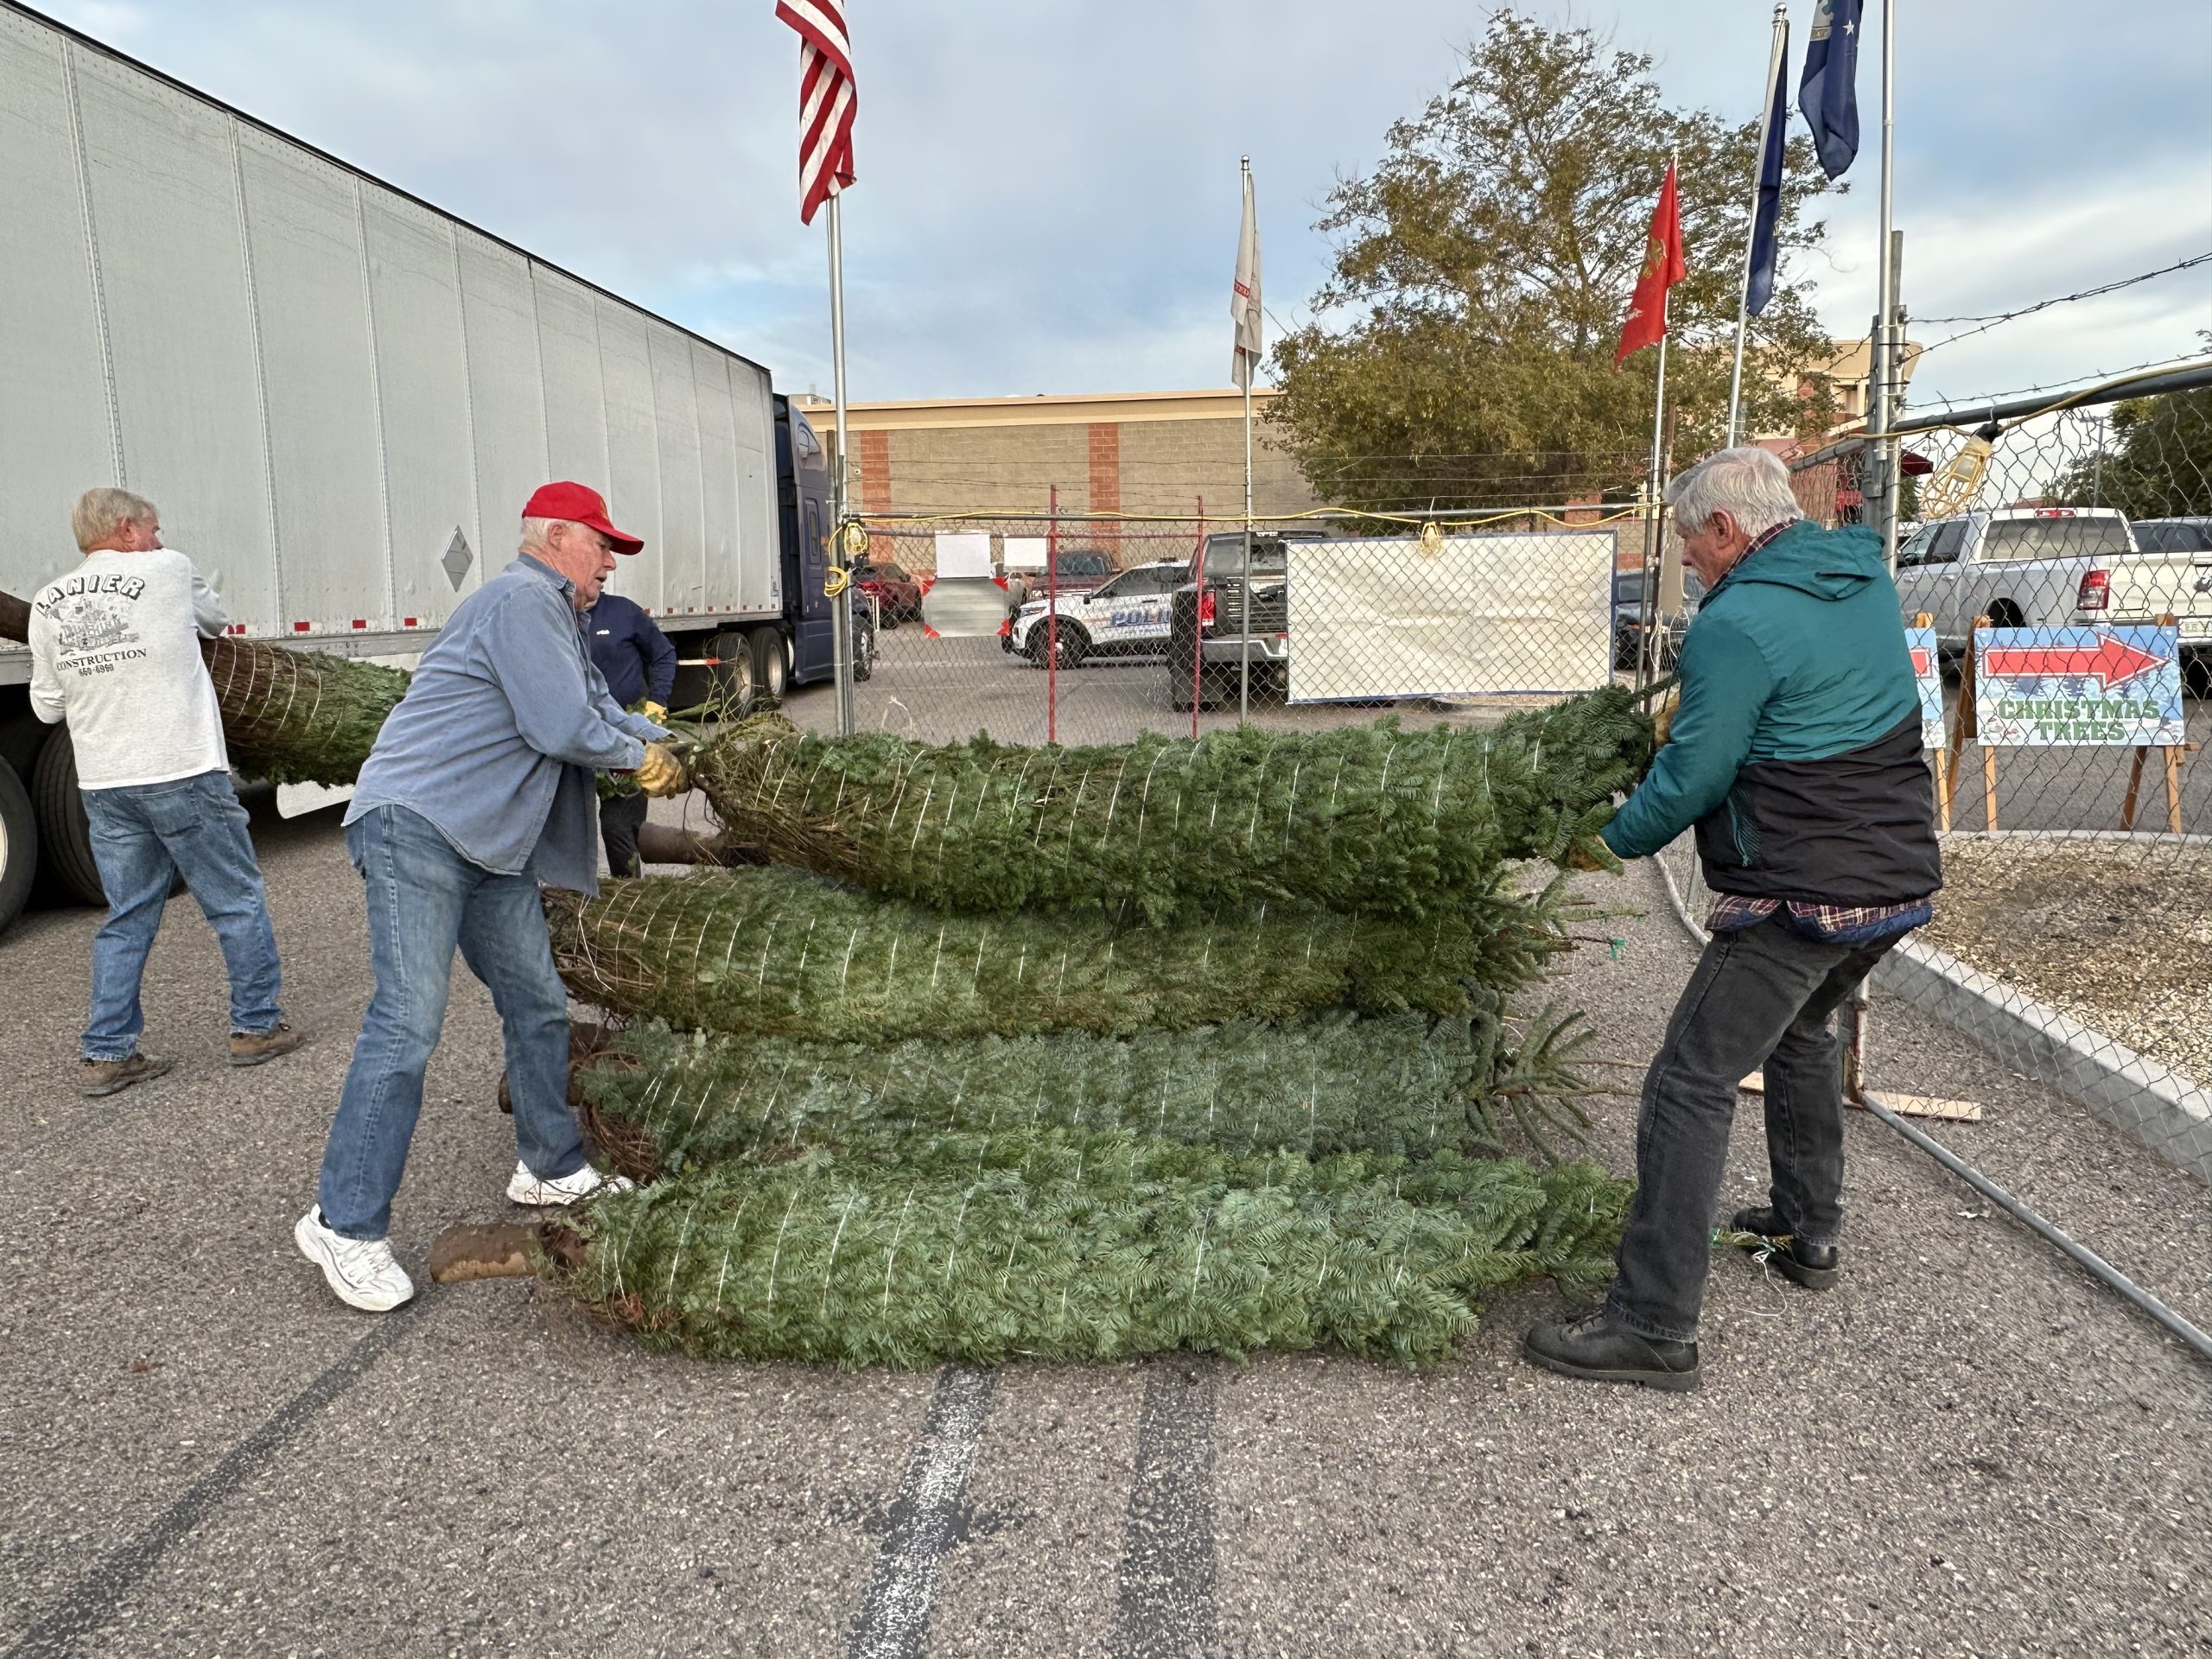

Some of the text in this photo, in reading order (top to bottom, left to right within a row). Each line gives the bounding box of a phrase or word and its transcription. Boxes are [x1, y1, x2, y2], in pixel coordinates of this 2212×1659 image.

[35, 575, 144, 619] LANIER
[57, 649, 146, 671] CONSTRUCTION
[1999, 700, 2160, 719] CHRISTMAS
[2039, 721, 2126, 741] TREES
